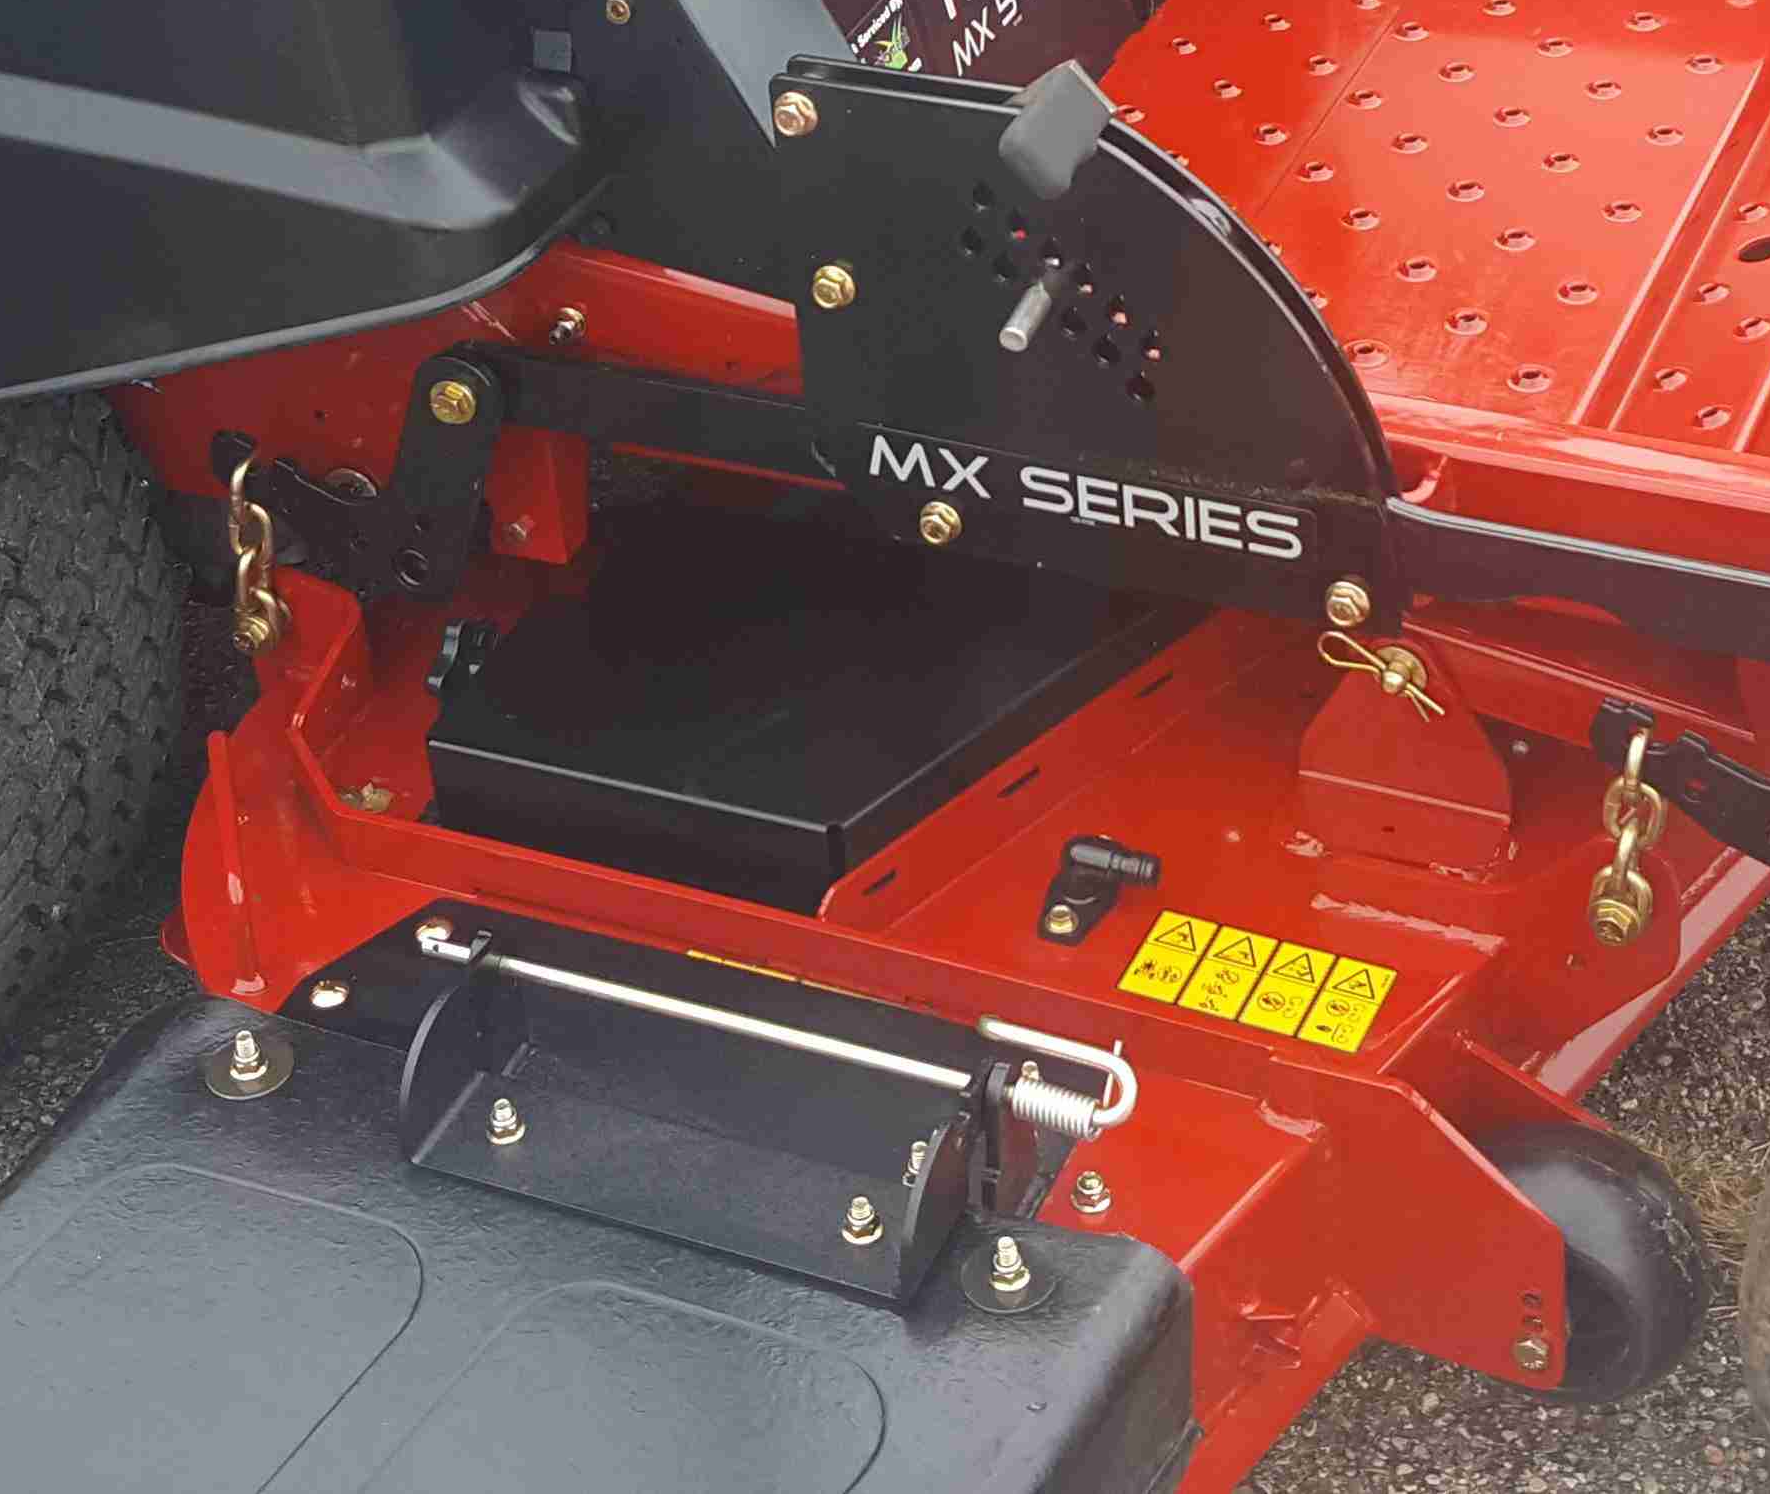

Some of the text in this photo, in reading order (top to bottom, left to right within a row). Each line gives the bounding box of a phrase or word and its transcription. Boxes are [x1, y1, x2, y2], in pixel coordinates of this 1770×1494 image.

[952, 6, 996, 77] MX
[868, 434, 1304, 561] MX SERIES
